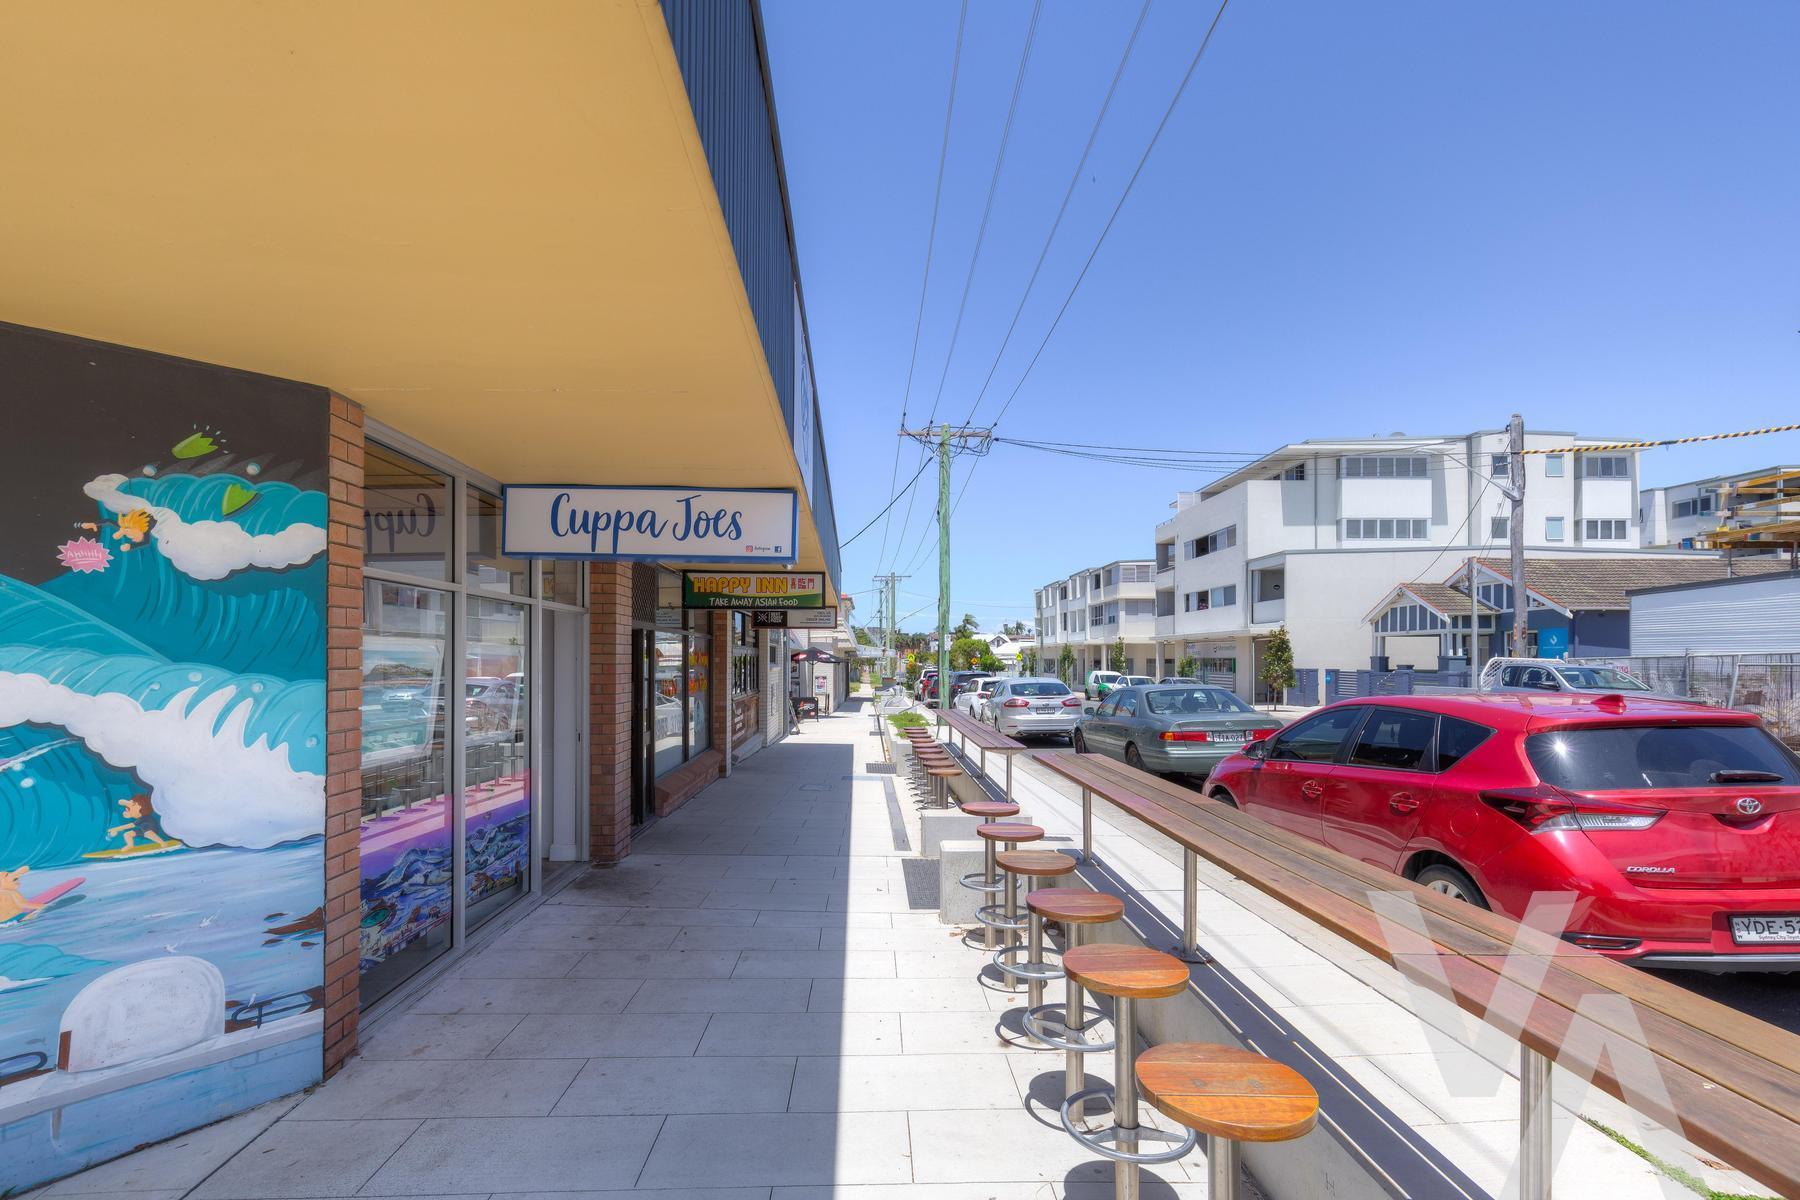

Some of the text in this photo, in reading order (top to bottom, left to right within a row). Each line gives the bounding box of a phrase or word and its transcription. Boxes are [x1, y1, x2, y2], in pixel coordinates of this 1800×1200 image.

[551, 492, 743, 553] Cuppa Joes
[693, 576, 788, 593] HAPPY INN
[709, 598, 729, 607] TAKE
[730, 597, 753, 607] AWAY
[755, 597, 777, 607] ASIAN
[1626, 866, 1676, 874] COROLLA
